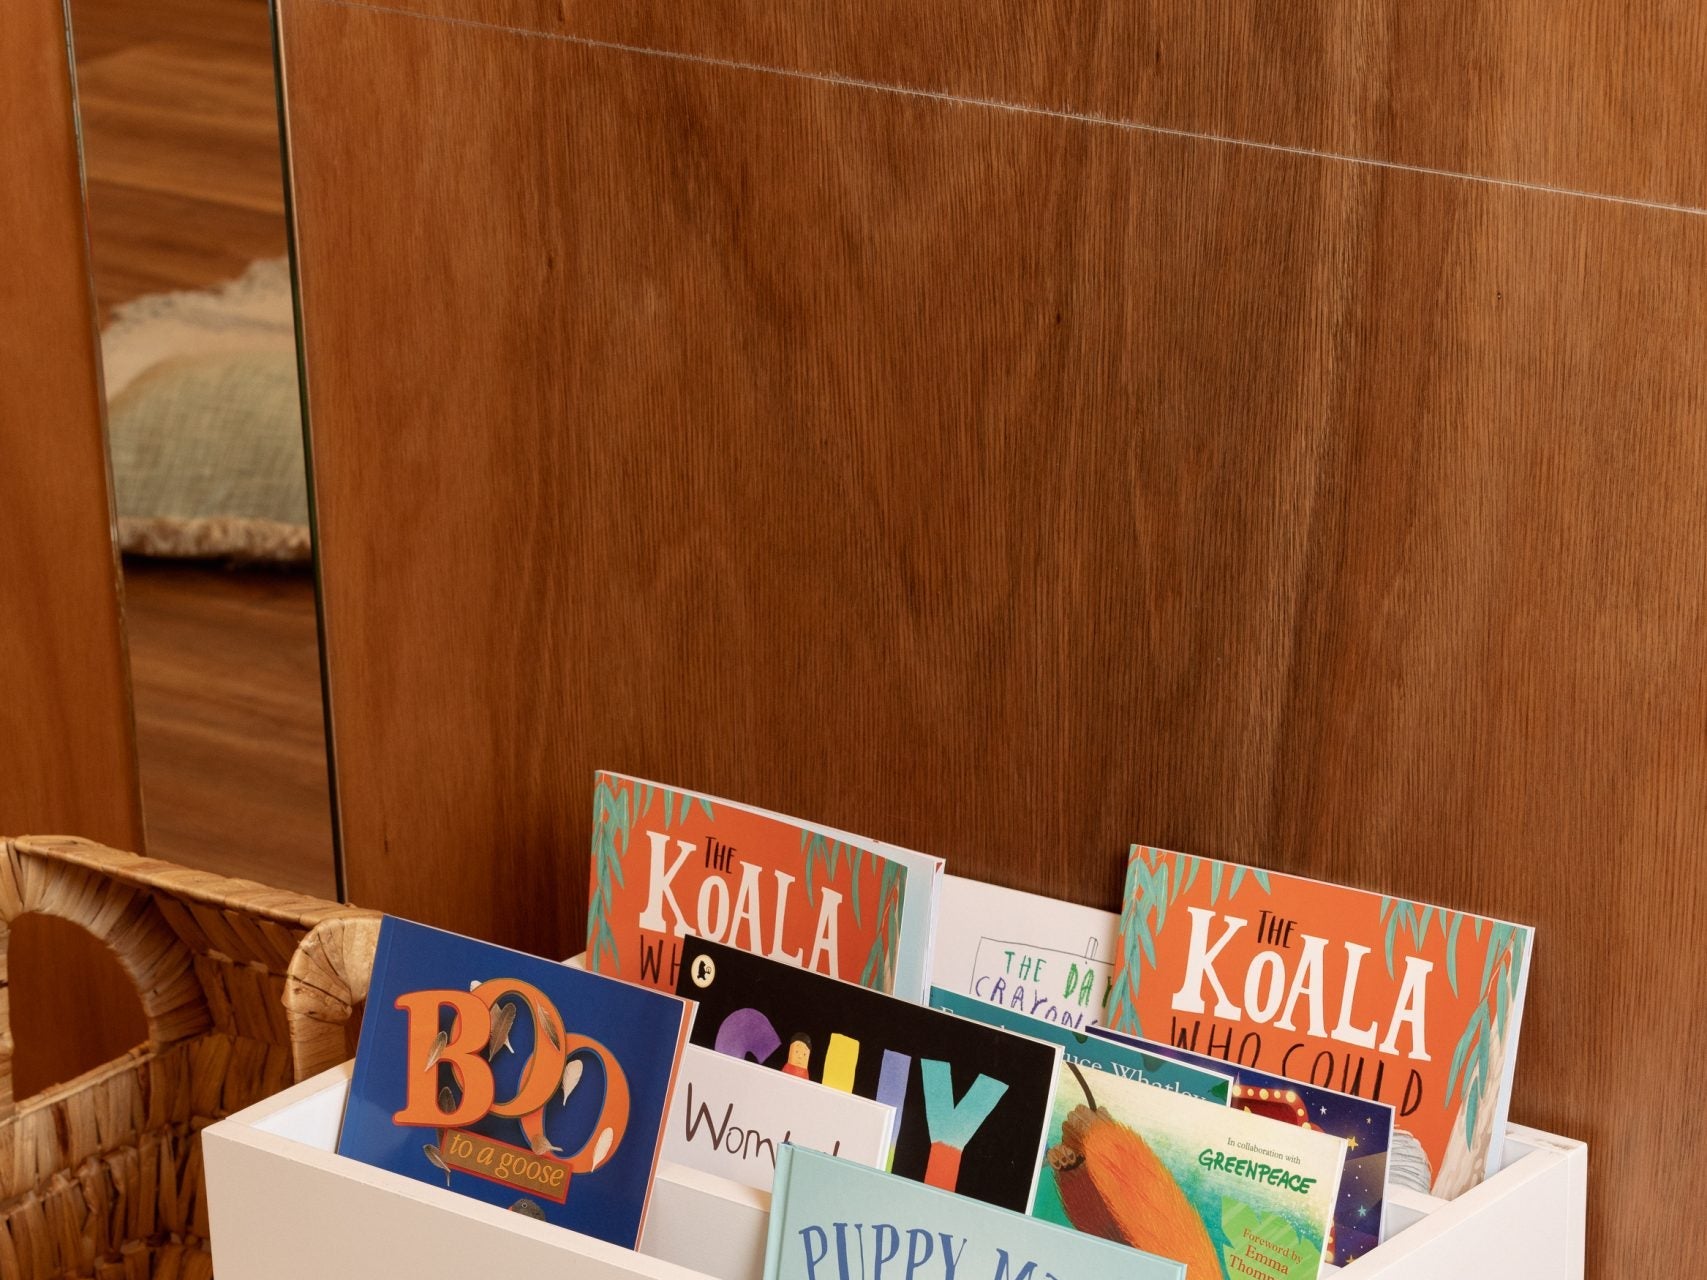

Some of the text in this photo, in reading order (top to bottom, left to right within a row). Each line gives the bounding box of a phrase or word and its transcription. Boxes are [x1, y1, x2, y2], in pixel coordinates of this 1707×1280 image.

[704, 836, 737, 874] THE
[638, 830, 843, 980] KOALA
[1258, 909, 1299, 950] THE
[640, 934, 680, 987] WH
[1004, 951, 1047, 982] THE
[1171, 906, 1435, 1063] KOALA
[975, 976, 1099, 1030] CRAYON
[392, 978, 631, 1174] BOO
[1170, 1016, 1423, 1117] WHO COULD
[449, 1134, 565, 1187] to a goose
[1198, 1148, 1318, 1195] GREENPEACE
[1227, 1137, 1302, 1166] In collaboration with
[1243, 1228, 1304, 1265] Foreword by
[1245, 1244, 1289, 1276] Emma
